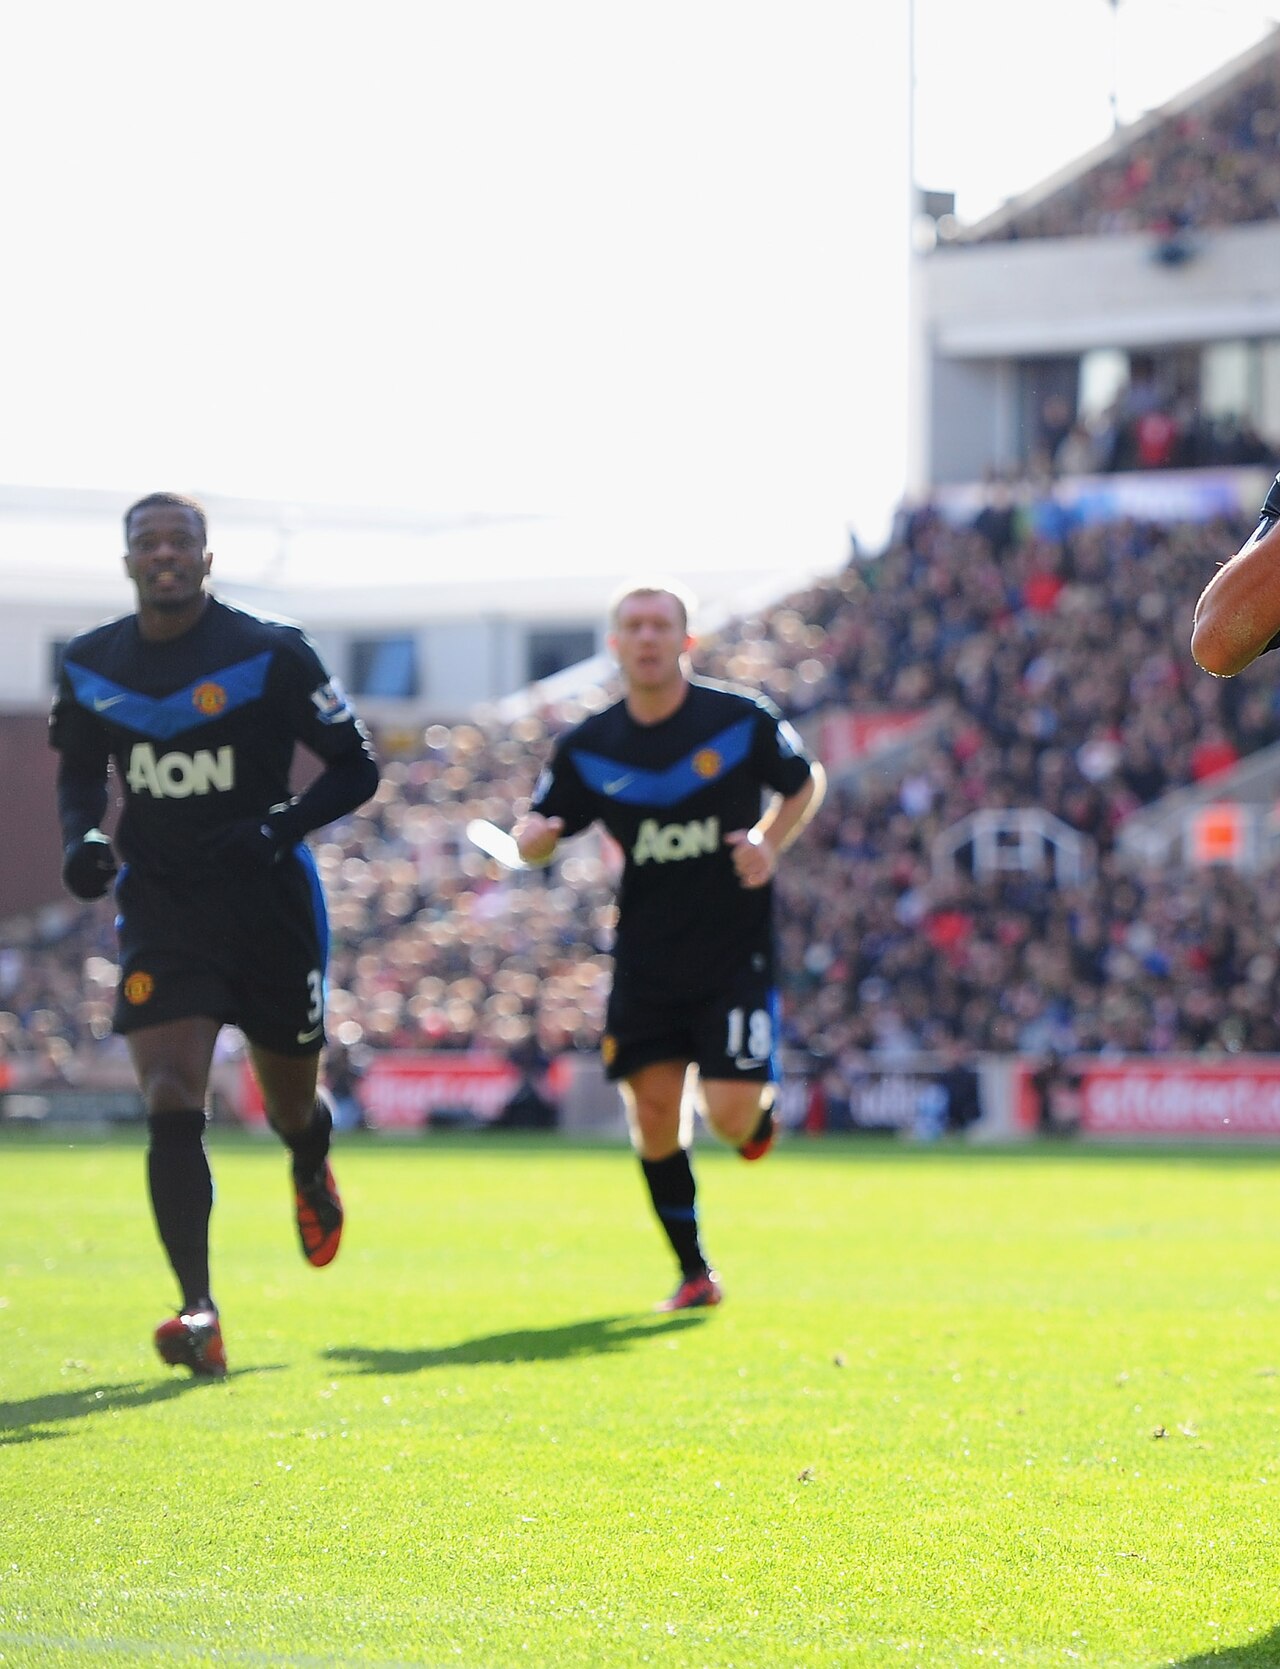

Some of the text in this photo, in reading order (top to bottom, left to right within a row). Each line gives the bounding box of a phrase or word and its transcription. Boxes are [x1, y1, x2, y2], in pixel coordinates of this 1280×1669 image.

[126, 742, 234, 799] AON
[633, 815, 720, 866] AON
[307, 968, 322, 1023] 3
[726, 1007, 771, 1060] 18
